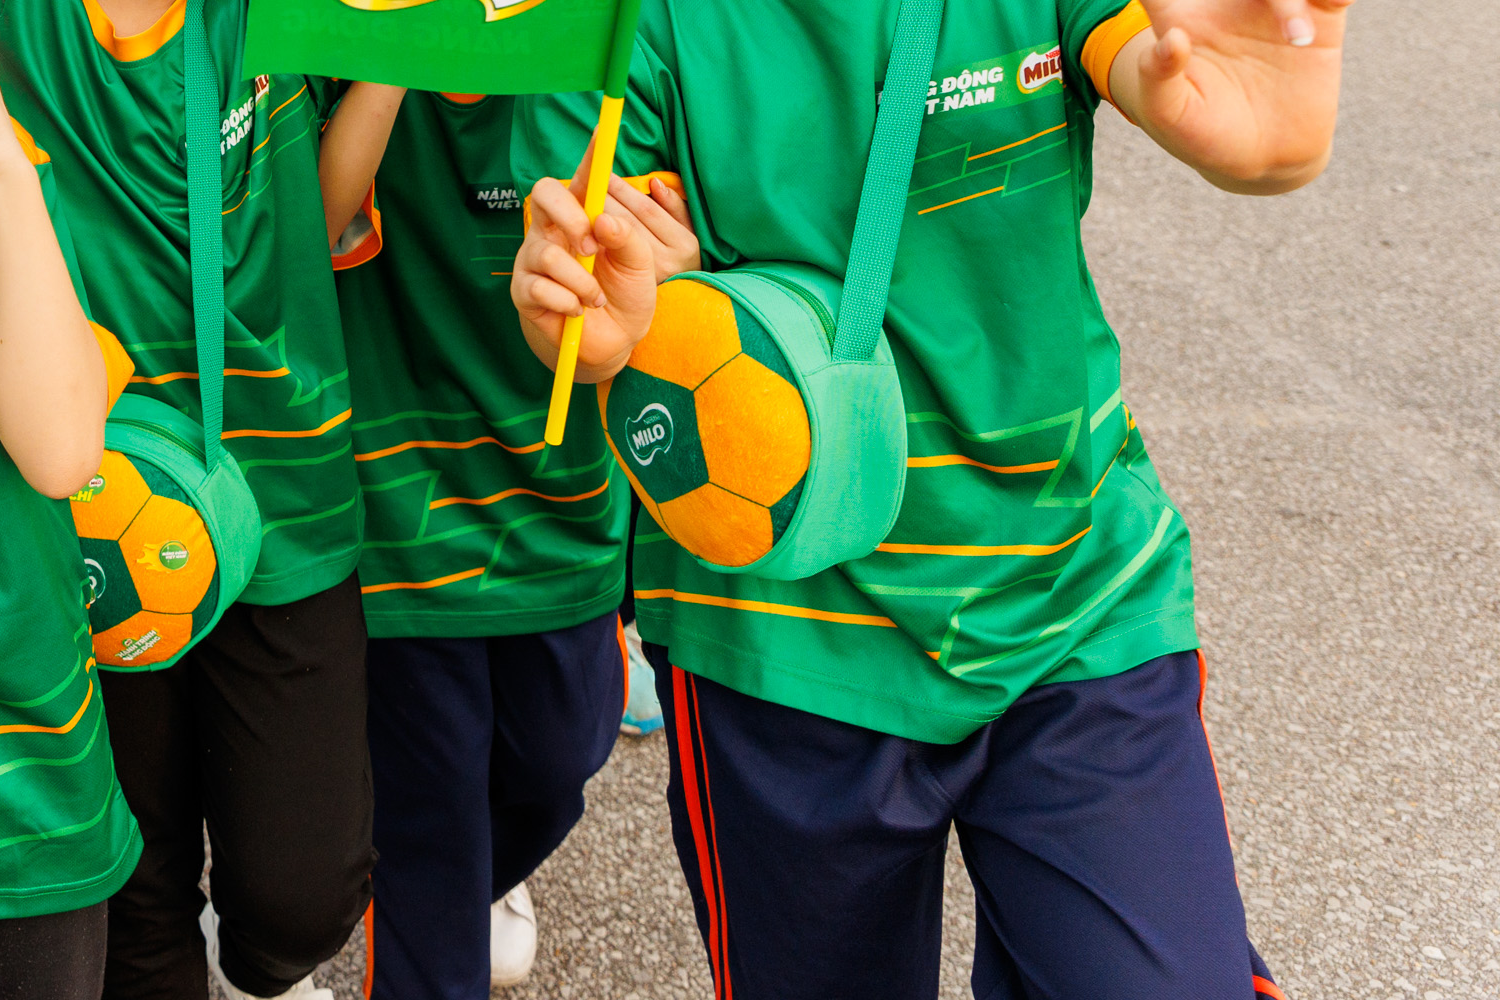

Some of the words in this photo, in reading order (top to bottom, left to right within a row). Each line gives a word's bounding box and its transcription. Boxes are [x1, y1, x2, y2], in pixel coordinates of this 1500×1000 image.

[940, 67, 1004, 93] ĐỘNG
[941, 86, 996, 112] NAM
[220, 96, 254, 136] ĐỘNG
[226, 115, 253, 151] NAM
[632, 424, 665, 450] MILO
